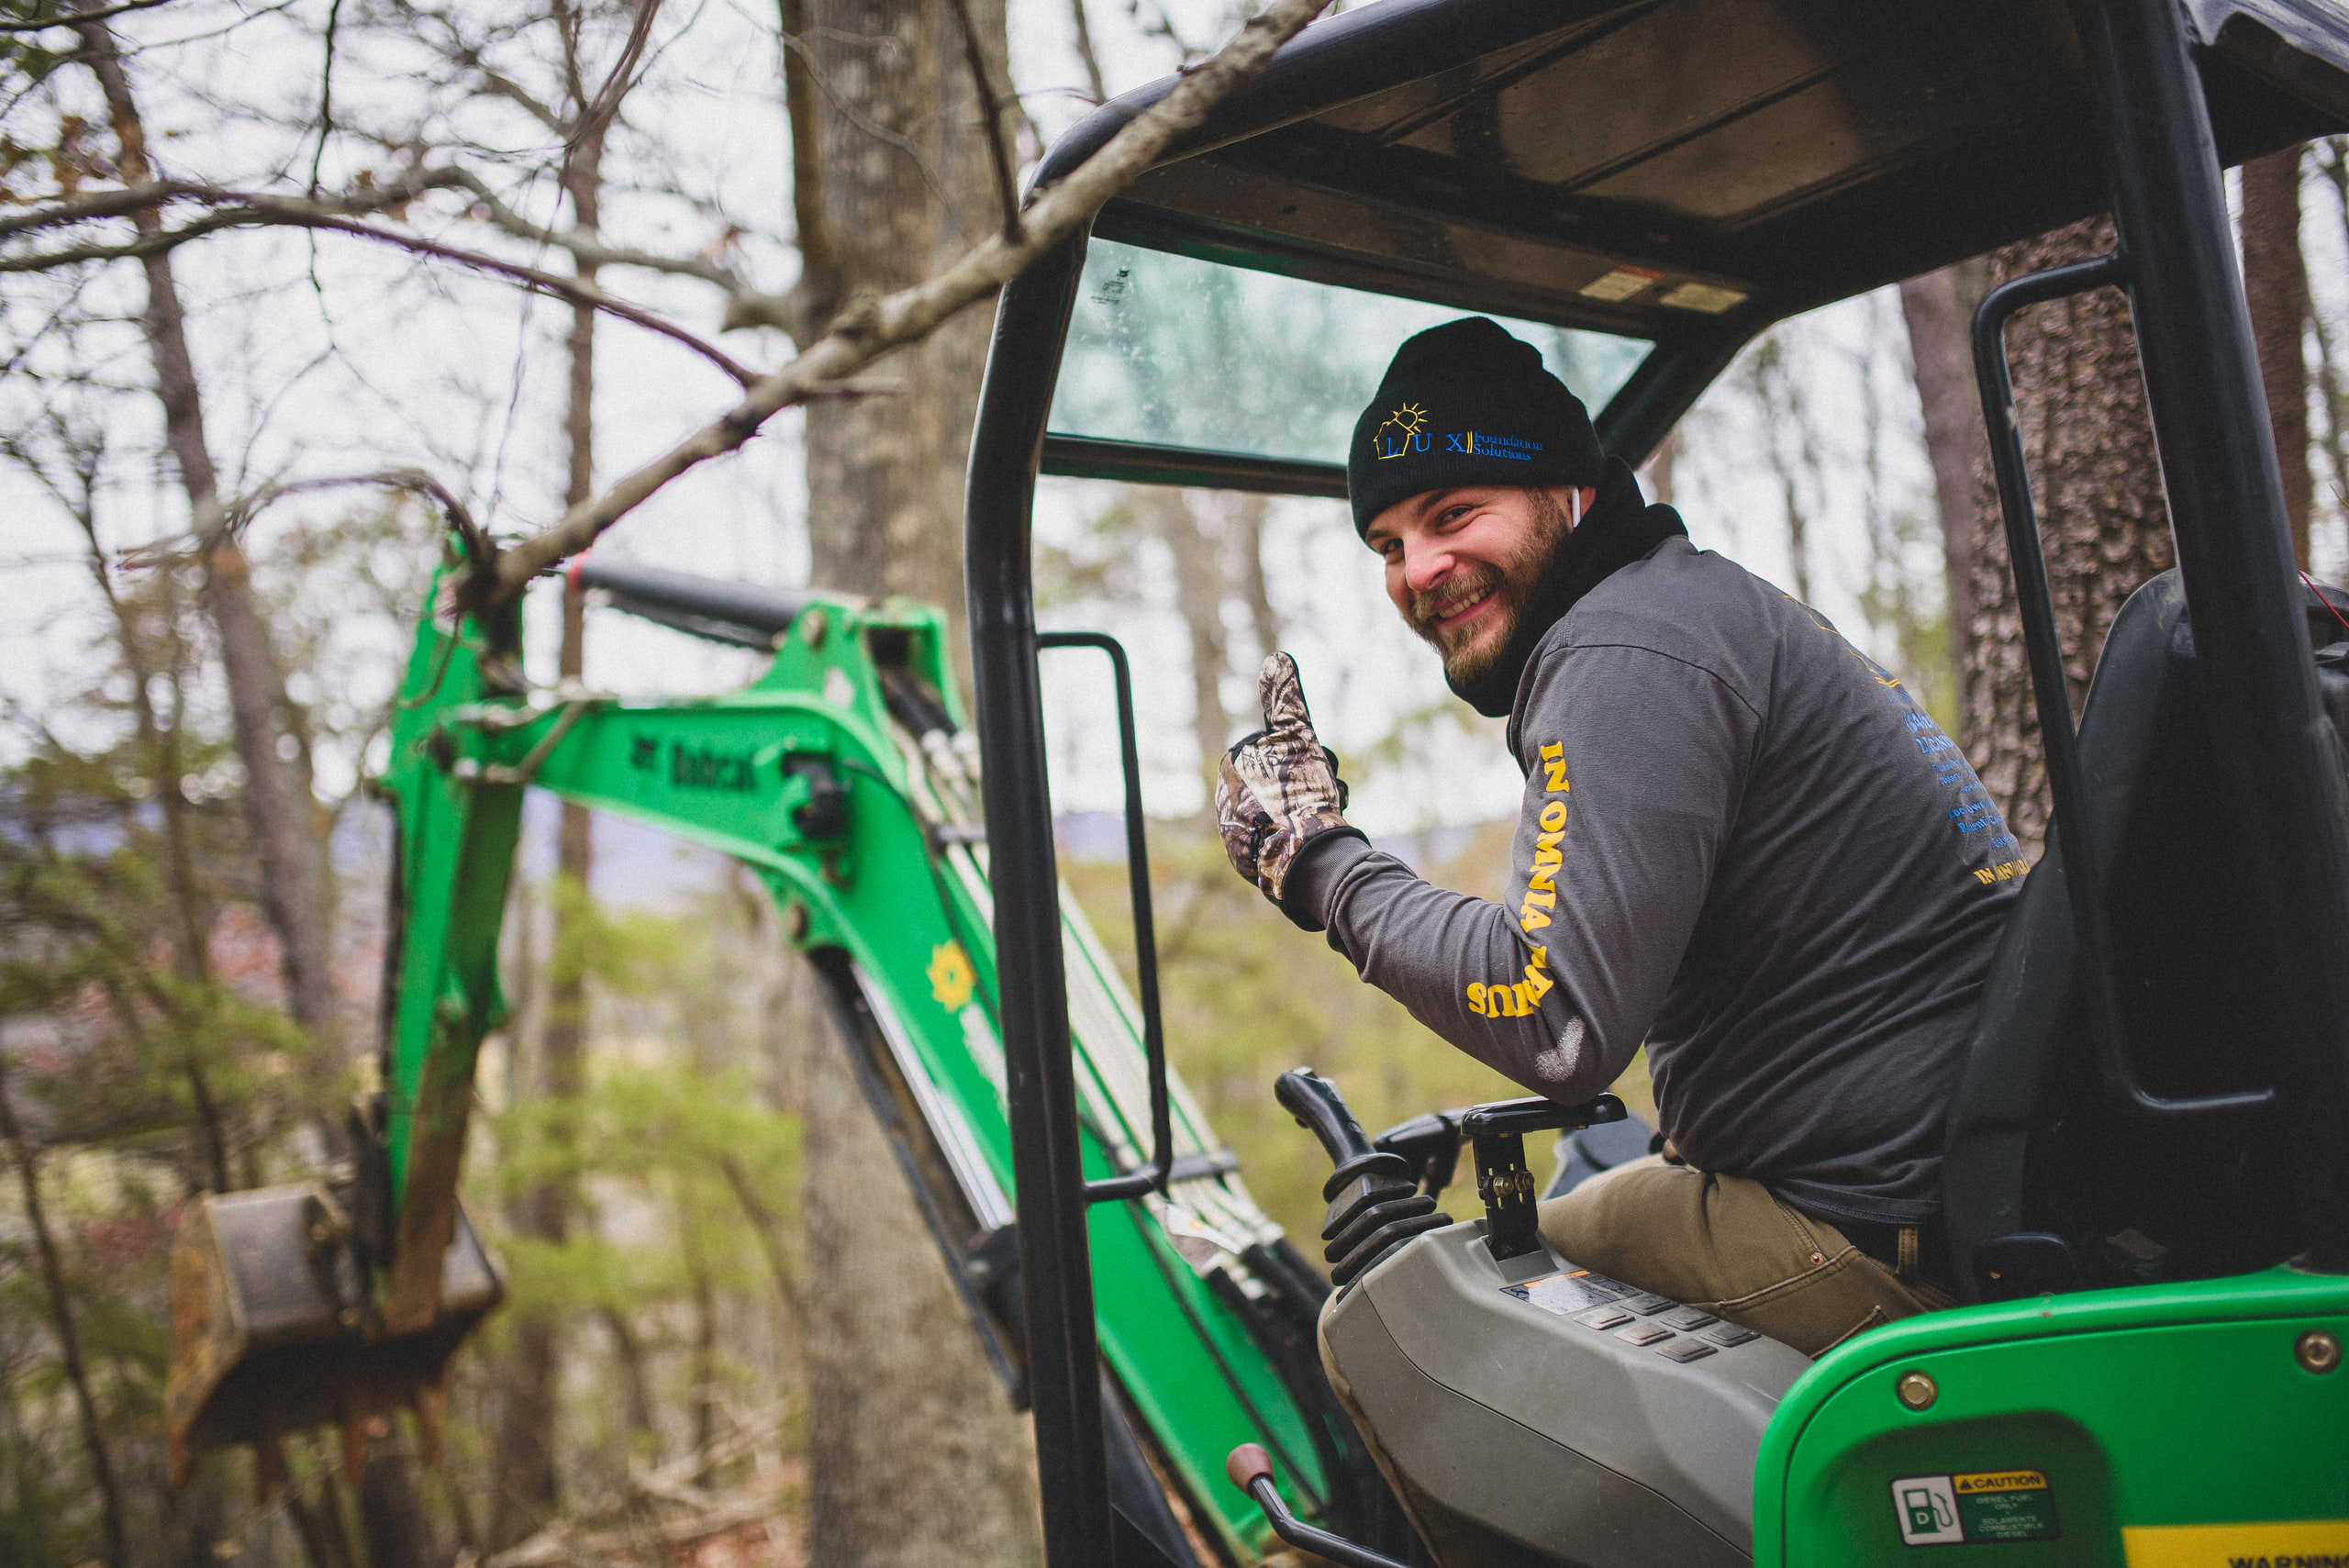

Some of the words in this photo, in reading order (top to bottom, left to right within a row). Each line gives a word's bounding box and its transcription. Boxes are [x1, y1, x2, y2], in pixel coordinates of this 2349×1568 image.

[1474, 430, 1543, 450] Foundation
[1473, 443, 1531, 461] Solutions
[1541, 740, 1570, 792] IN
[1520, 800, 1567, 933] OMNIA
[1974, 1474, 2042, 1489] CAUTION
[1976, 1496, 2009, 1505] DIESEL
[2010, 1494, 2034, 1503] FUEL
[1995, 1503, 2019, 1511] ONLY
[1916, 1512, 1930, 1525] D
[1982, 1515, 2038, 1526] SOLAMENTE
[1978, 1522, 2043, 1533] COMBUSTIBLE
[1997, 1529, 2028, 1540] DIESEL
[2228, 1553, 2349, 1568] WARNIN
